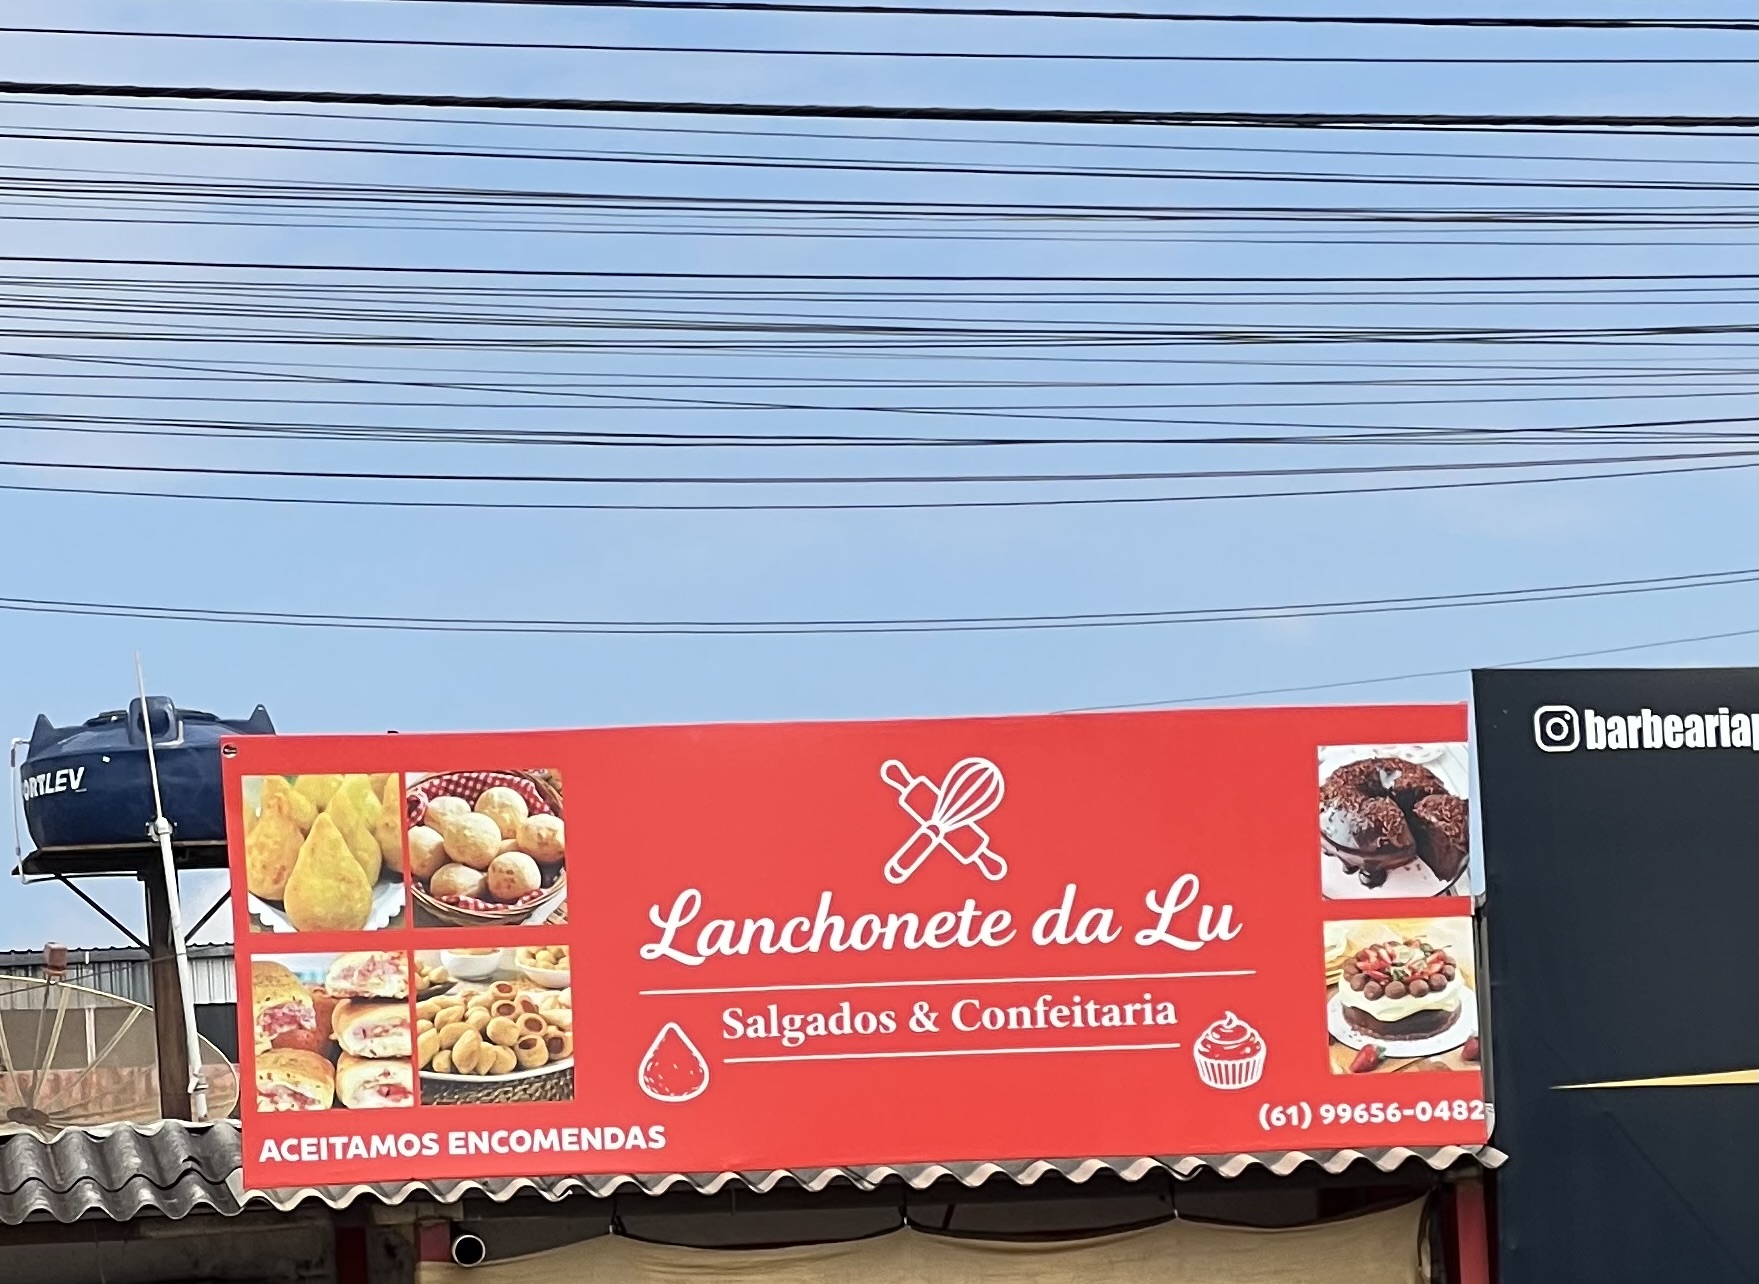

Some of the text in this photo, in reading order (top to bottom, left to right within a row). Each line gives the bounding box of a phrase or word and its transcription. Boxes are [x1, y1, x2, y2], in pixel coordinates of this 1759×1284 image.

[22, 767, 85, 801] ORTLEV
[640, 873, 1243, 965] Lanchonete da Lu
[722, 992, 1178, 1048] Salgados & Confeitaria
[1258, 1099, 1485, 1131] (61) 99656-0482
[258, 1125, 667, 1163] ACEITAMOS ENCOMENDAS
